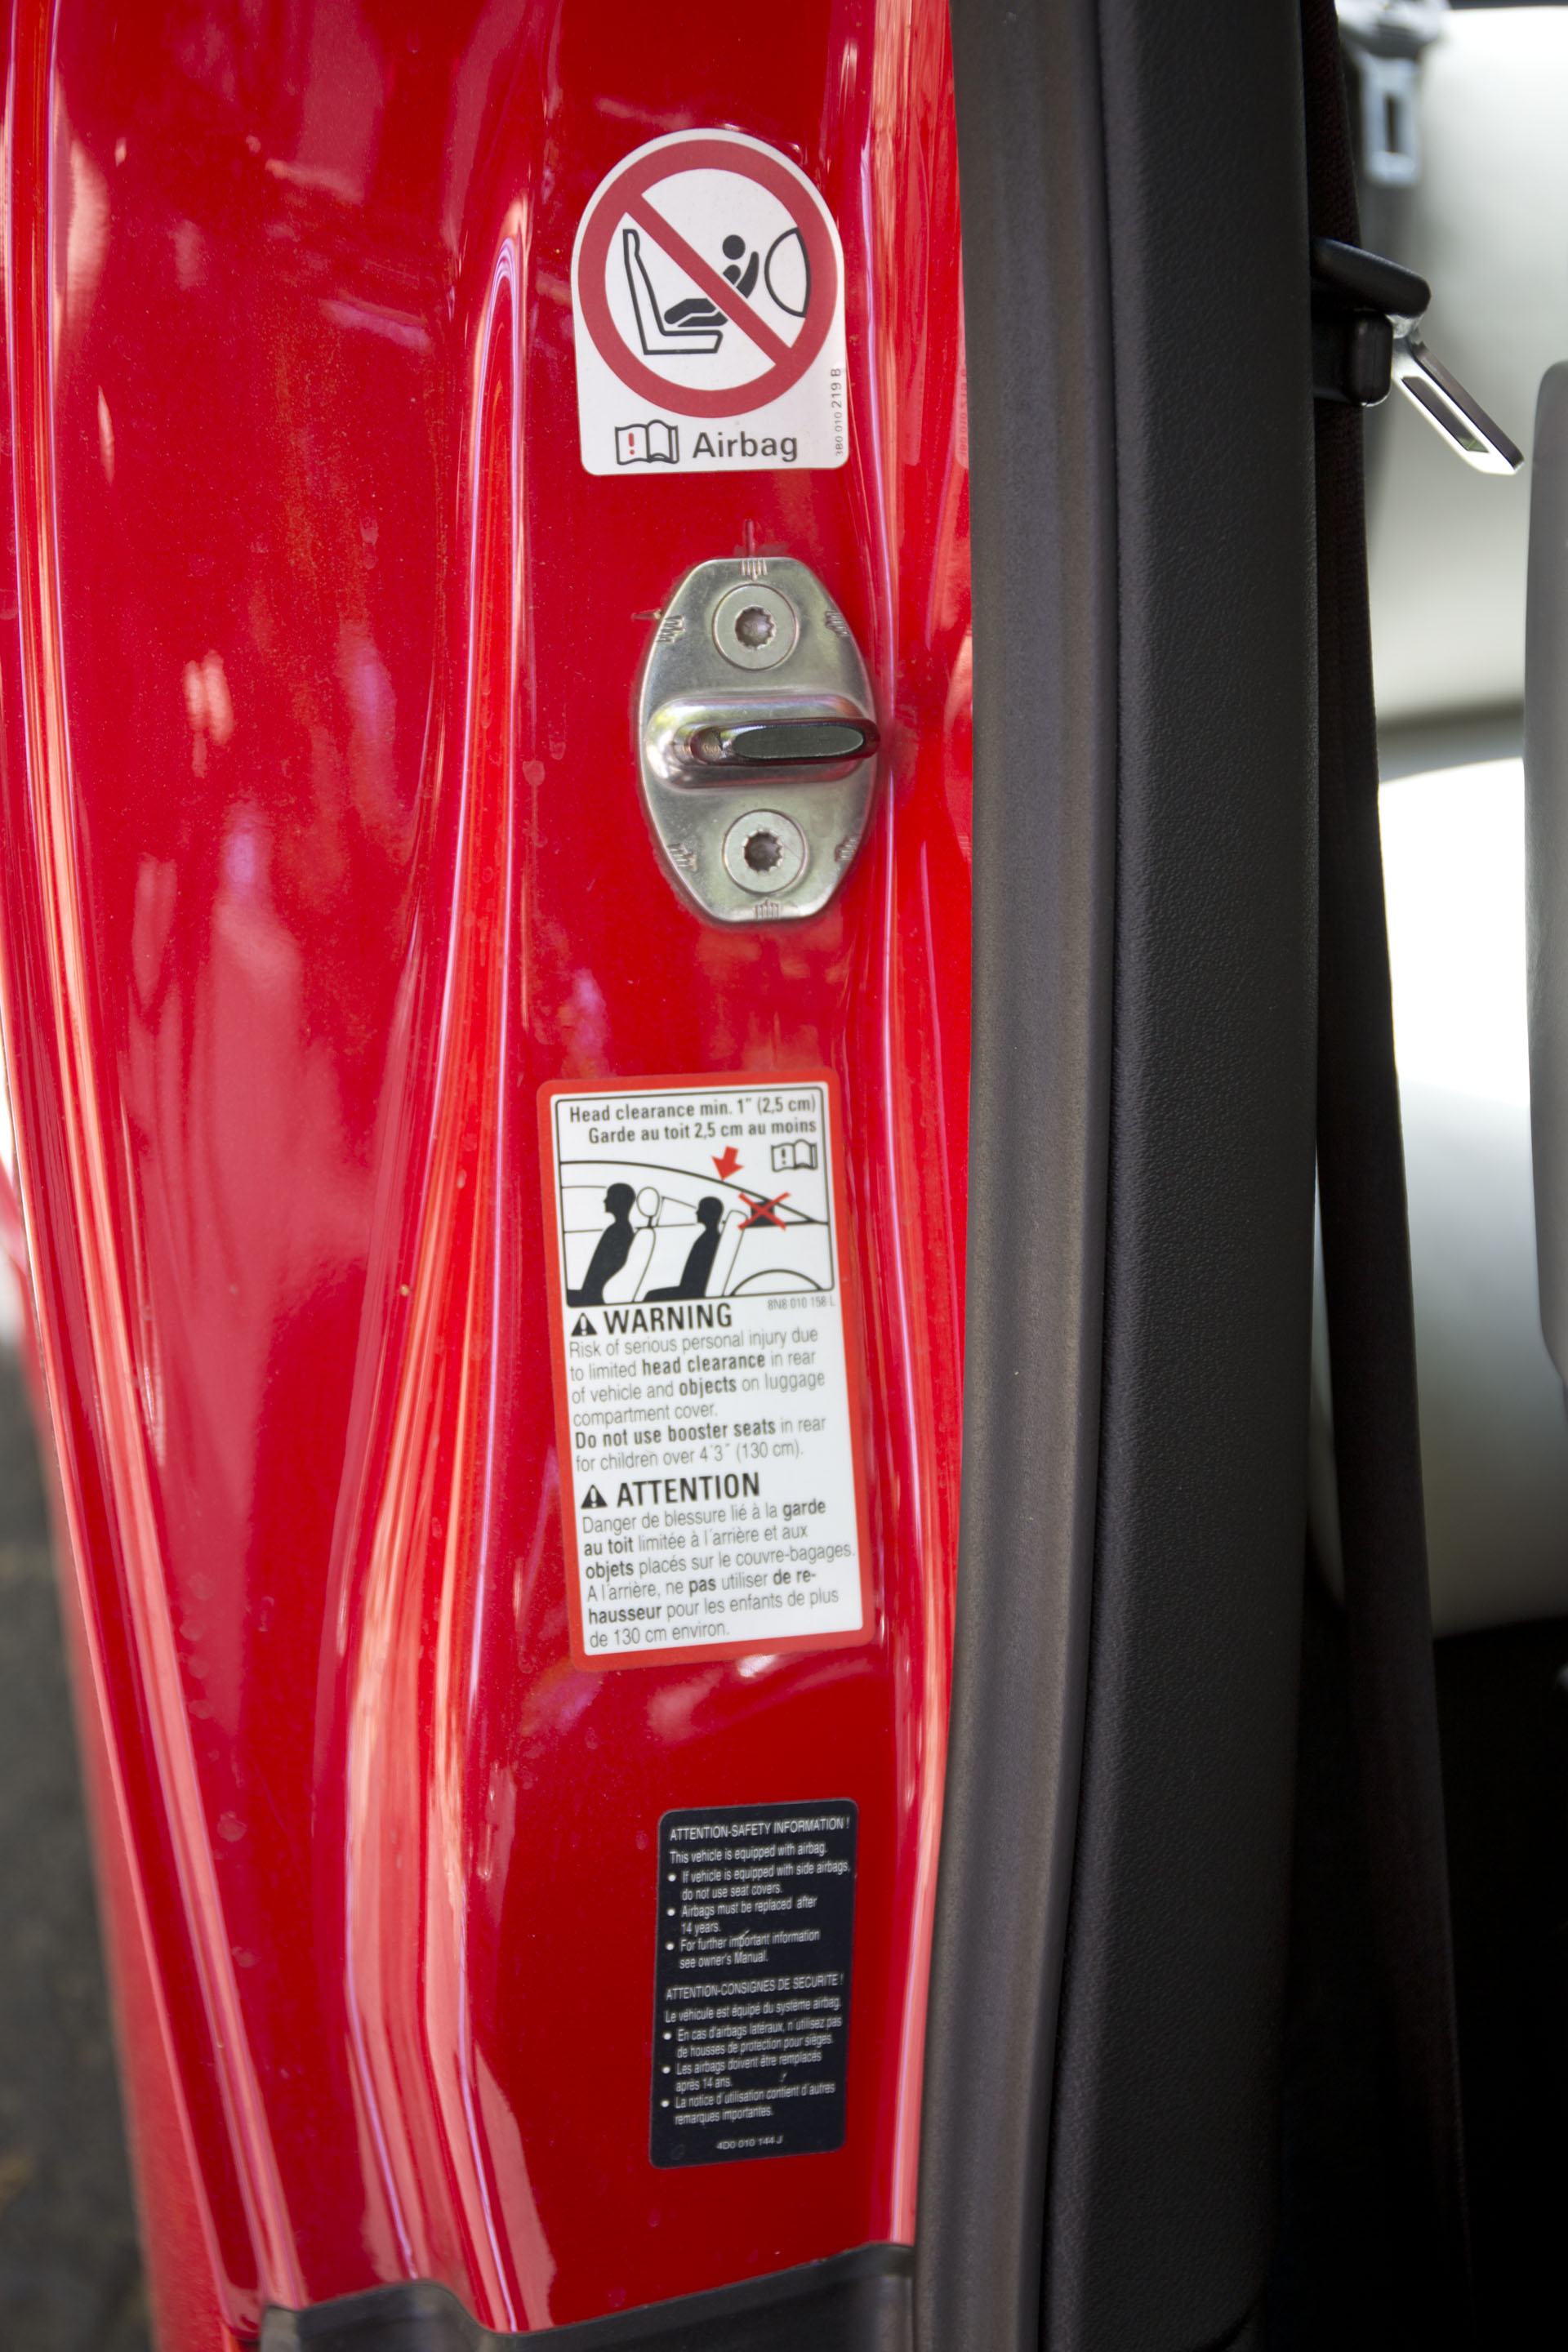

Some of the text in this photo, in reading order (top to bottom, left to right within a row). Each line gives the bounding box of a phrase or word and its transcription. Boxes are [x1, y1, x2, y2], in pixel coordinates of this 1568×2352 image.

[831, 368, 841, 376] B
[831, 382, 842, 408] 219
[693, 431, 797, 462] Airbag
[570, 1105, 610, 1123] Head
[616, 1102, 694, 1120] clearance
[701, 1099, 732, 1116] min.
[788, 1094, 816, 1114] cm)
[589, 1118, 816, 1143] Garde au toit 2,5 cm au moins
[791, 1297, 807, 1308] 010
[604, 1303, 732, 1334] WARNING
[570, 1327, 817, 1358] Risk of serious personal injury due
[571, 1351, 816, 1381] to limited head clearance in rear
[572, 1371, 824, 1404] of vehicle and objects on luggage
[573, 1404, 717, 1428] compartment cover.
[576, 1417, 826, 1449] Do not use booster seats in rear
[577, 1455, 595, 1472] for
[601, 1450, 657, 1470] children
[663, 1450, 694, 1464] over
[737, 1442, 768, 1463] (130
[617, 1472, 760, 1508] ATTENTION
[582, 1499, 826, 1537] Danger de blessure lié à la garde
[584, 1526, 808, 1556] au toit limitée à et aux
[586, 1542, 854, 1583] objets placés sur le couvre-bagages.
[587, 1567, 816, 1601] A ne pas utiliser de re-
[589, 1588, 839, 1624] hausseur pour les enfants de plus
[590, 1620, 730, 1648] de 130 cm environ.
[774, 1818, 844, 1833] INFORMATION
[670, 1851, 688, 1864] This
[692, 1848, 721, 1861] vehicle
[724, 1847, 732, 1860] is
[735, 1845, 775, 1862] equipped
[777, 1843, 795, 1856] with
[683, 1863, 813, 1883] If vehicle is equipped with side
[683, 1883, 782, 1900] do not use seat covers.
[682, 1895, 817, 1919] Airbags must be replaced after
[680, 1930, 820, 1952] For further important information
[682, 1922, 720, 1936] 14 years.
[680, 1950, 768, 1969] see owner's Manual.
[777, 1977, 791, 1990] DE
[666, 2002, 774, 2023] Le véhicule est équipé du
[678, 2029, 689, 2042] En
[692, 2029, 706, 2040] cas
[827, 2016, 842, 2030] pas
[678, 2036, 803, 2058] de housses de pour
[676, 2059, 725, 2076] Les airbags
[702, 2075, 732, 2089] 14 ans.
[675, 2092, 714, 2109] La notice
[675, 2105, 773, 2127] remarques importantes.
[738, 2139, 755, 2148] 010
[758, 2137, 775, 2146] 144
